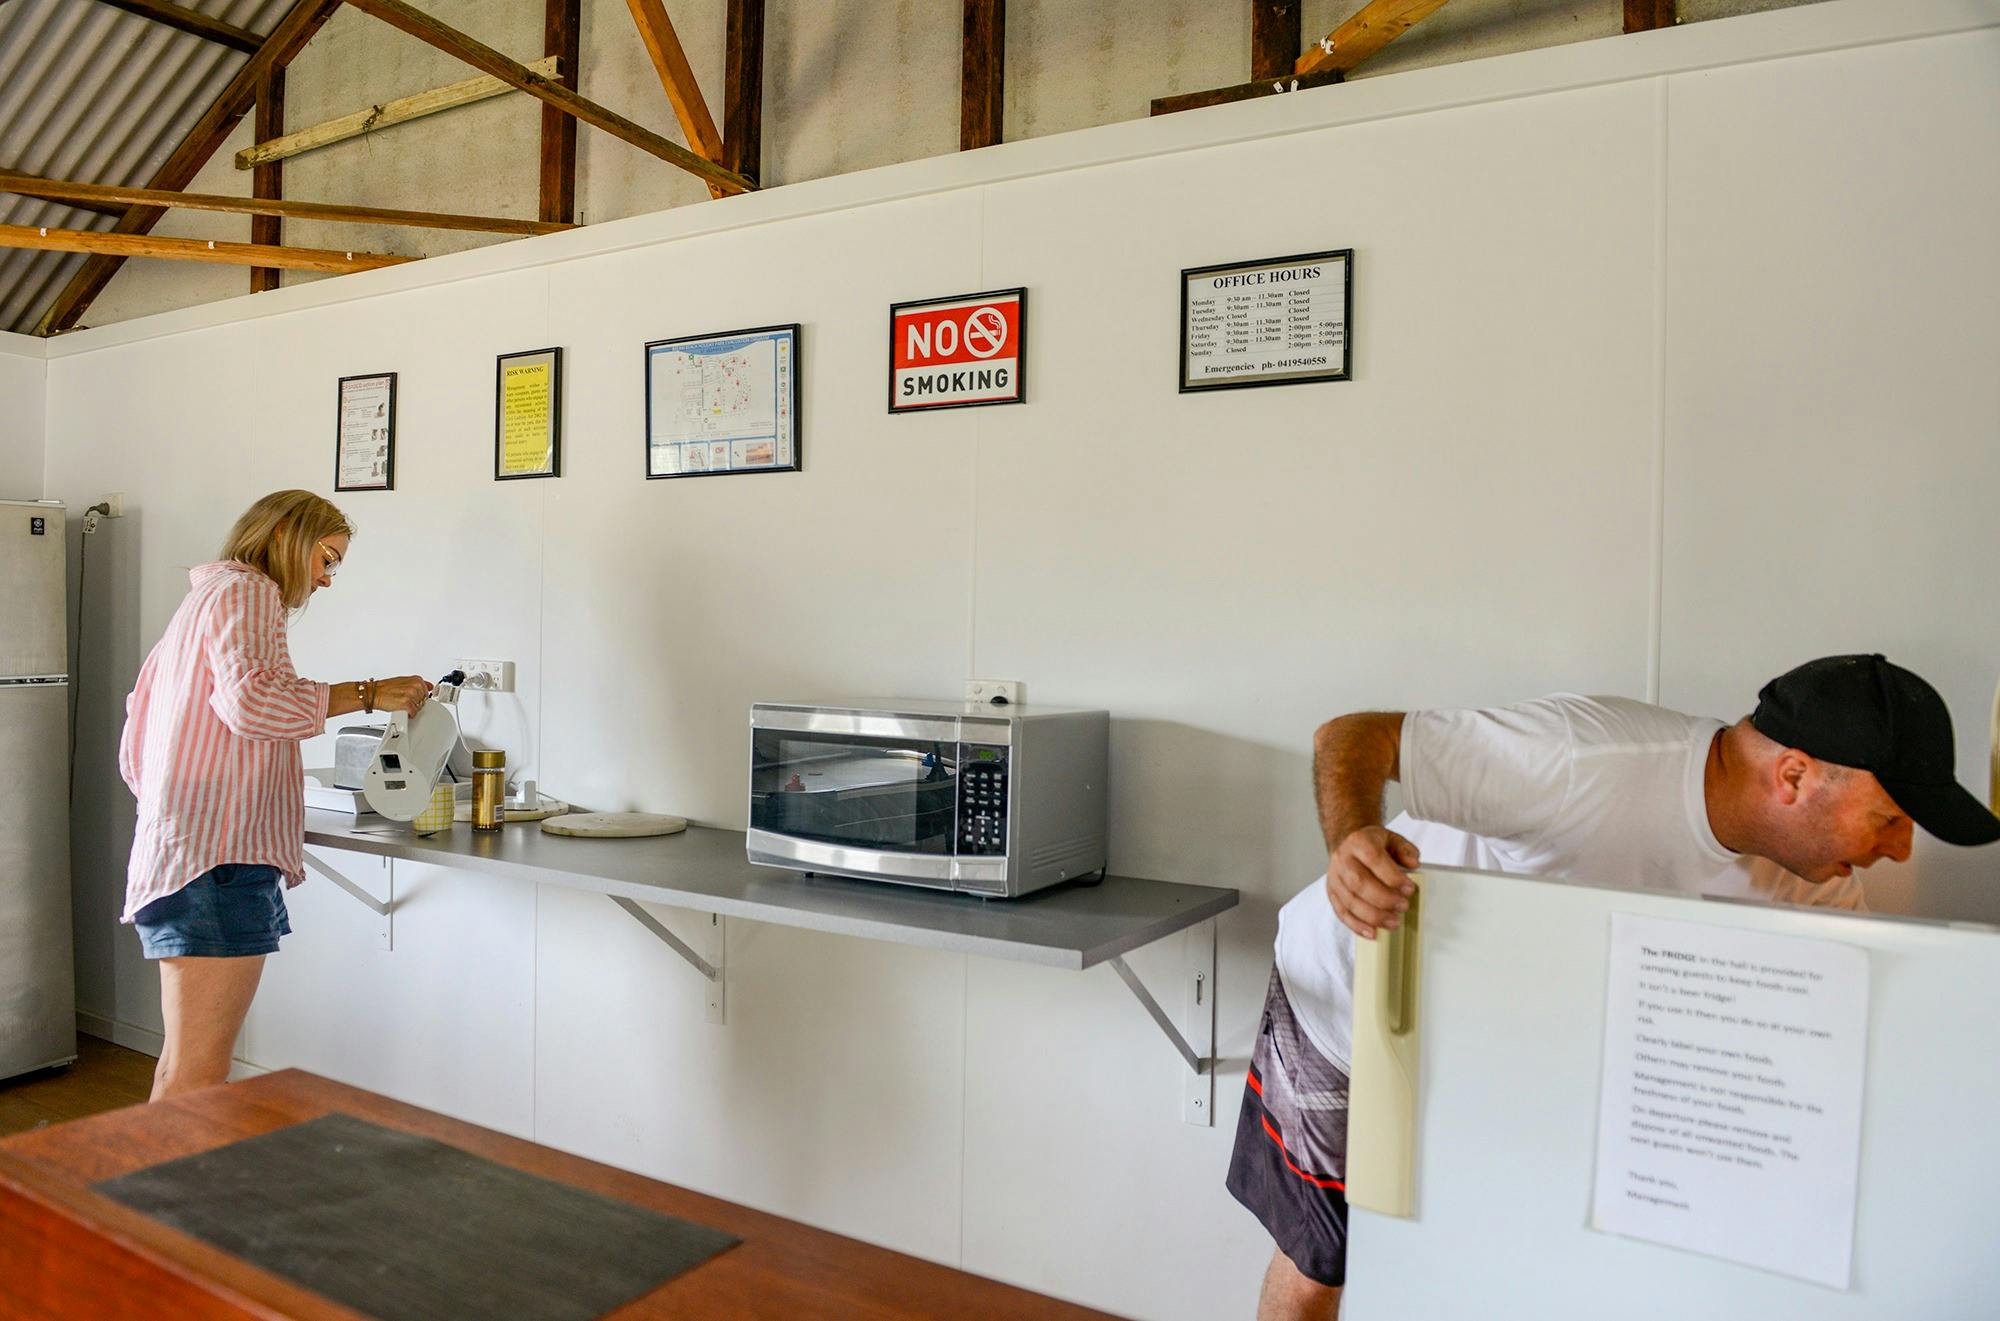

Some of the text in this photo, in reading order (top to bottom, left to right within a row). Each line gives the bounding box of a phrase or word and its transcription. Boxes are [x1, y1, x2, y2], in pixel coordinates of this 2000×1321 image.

[1213, 267, 1320, 288] OFFICE HOURS
[907, 318, 958, 360] NO
[1205, 362, 1254, 373] Emergencies
[1277, 356, 1326, 367] 0419540558
[903, 367, 1008, 396] SMOKING
[1640, 964, 1680, 976] camping
[1682, 970, 1713, 979] guests
[1642, 947, 1657, 955] The
[1661, 950, 1695, 962] FRIDGE
[1711, 958, 1726, 966] the
[1760, 966, 1806, 978] provided
[1647, 1003, 1664, 1011] you
[1720, 1015, 1738, 1023] you
[1809, 1030, 1831, 1038] own
[1636, 1034, 1667, 1047] Clearly
[1670, 1040, 1693, 1049] label
[1695, 1046, 1717, 1054] your
[1635, 1052, 1666, 1064] Others
[1692, 1064, 1729, 1076] remove
[1731, 1071, 1753, 1080] your
[1633, 1086, 1677, 1100] freshness
[1692, 1098, 1714, 1108] your
[1634, 1071, 1696, 1088] Management
[1729, 1090, 1786, 1106] responsible
[1631, 1120, 1666, 1132] dispose
[1695, 1134, 1744, 1149] unwanted
[1698, 1119, 1728, 1130] please
[1731, 1126, 1769, 1138] remove
[1772, 1134, 1791, 1144] and
[1652, 1140, 1682, 1150] guests
[1628, 1171, 1655, 1183] Thank
